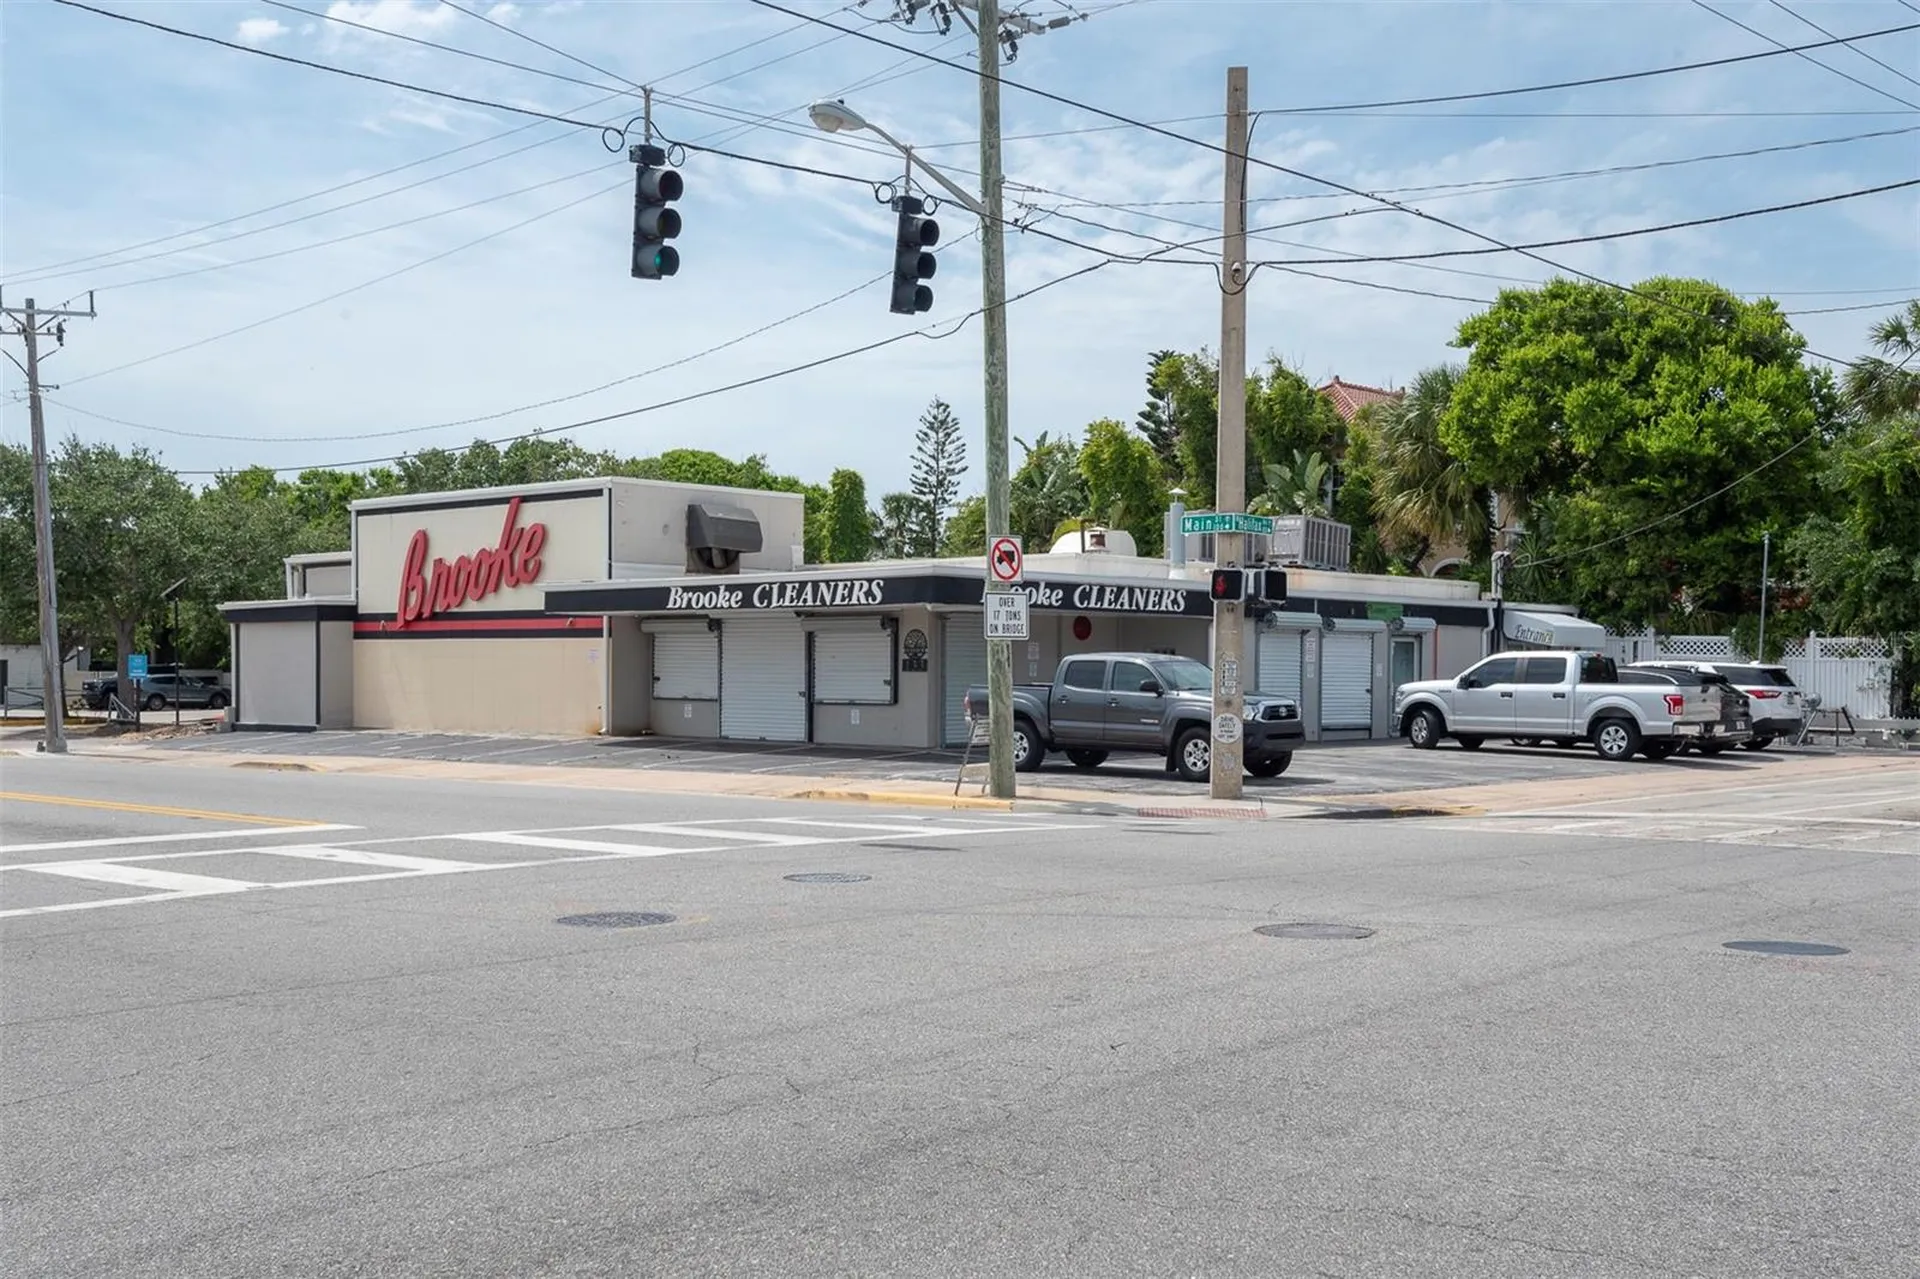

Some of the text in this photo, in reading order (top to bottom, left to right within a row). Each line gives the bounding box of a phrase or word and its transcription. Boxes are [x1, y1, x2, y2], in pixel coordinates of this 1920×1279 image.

[1184, 517, 1212, 532] Main
[396, 497, 545, 631] Brooke
[666, 579, 887, 610] Brooke CLEANERS
[1074, 584, 1188, 613] CLEANERS
[998, 597, 1016, 608] OVER
[993, 610, 1022, 622] 17 TONS
[989, 623, 1025, 635] ON BRIDGE
